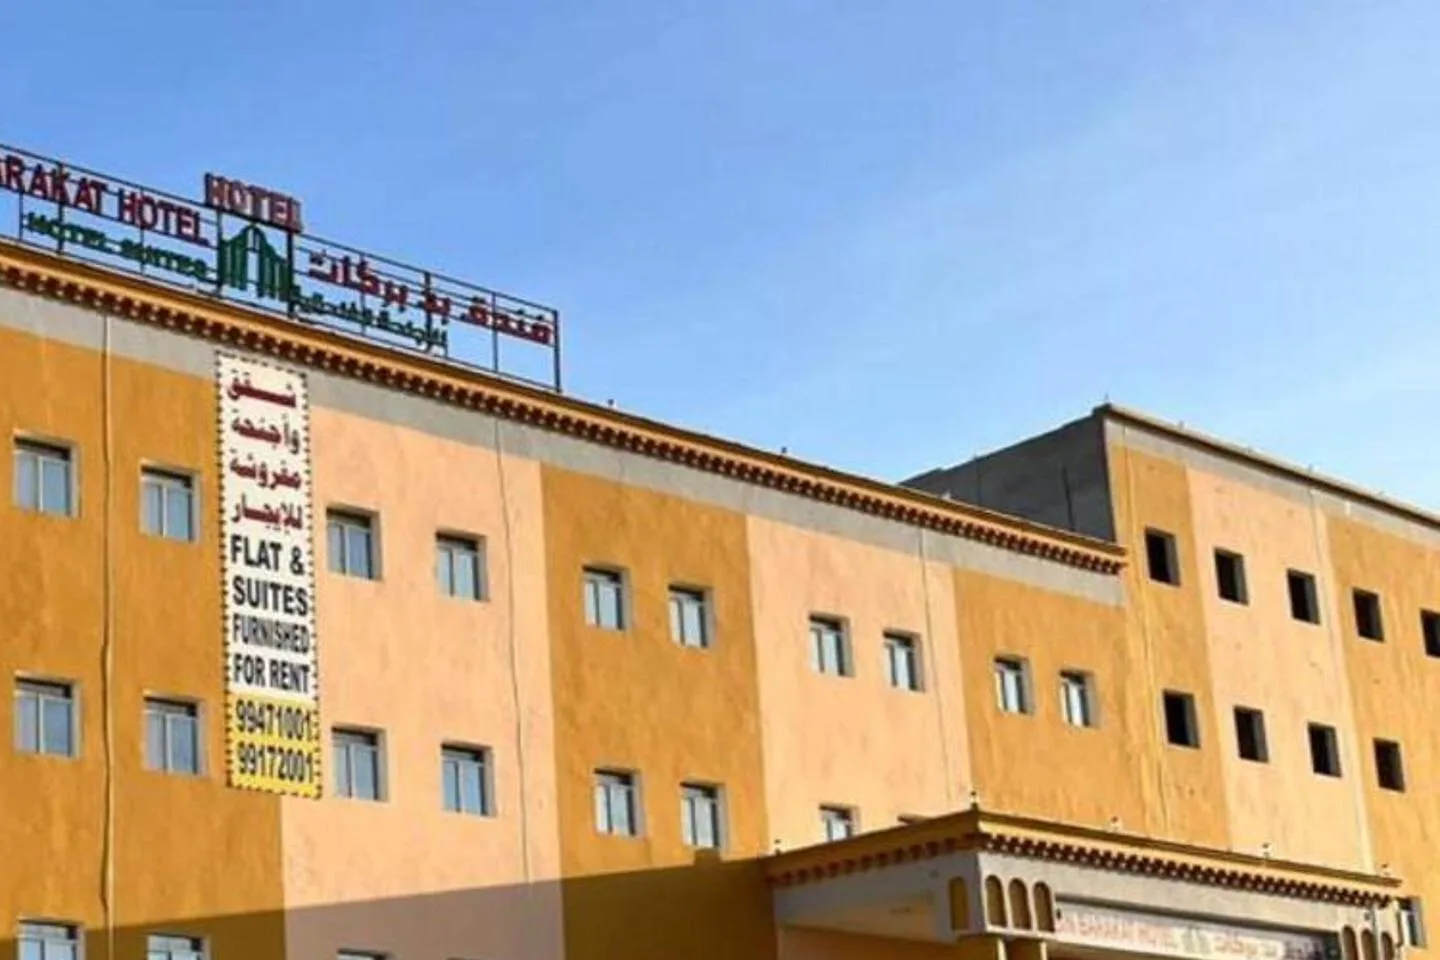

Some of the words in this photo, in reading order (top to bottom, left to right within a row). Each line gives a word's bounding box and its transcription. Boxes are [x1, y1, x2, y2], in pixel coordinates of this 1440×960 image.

[118, 188, 210, 247] HOTEL
[204, 172, 303, 234] HOTEL
[230, 534, 282, 571] FLAT
[289, 546, 305, 576] &
[232, 574, 309, 616] SUITES
[232, 614, 310, 654] FURNISHED
[233, 653, 266, 687] FOR
[269, 659, 310, 693] RENT
